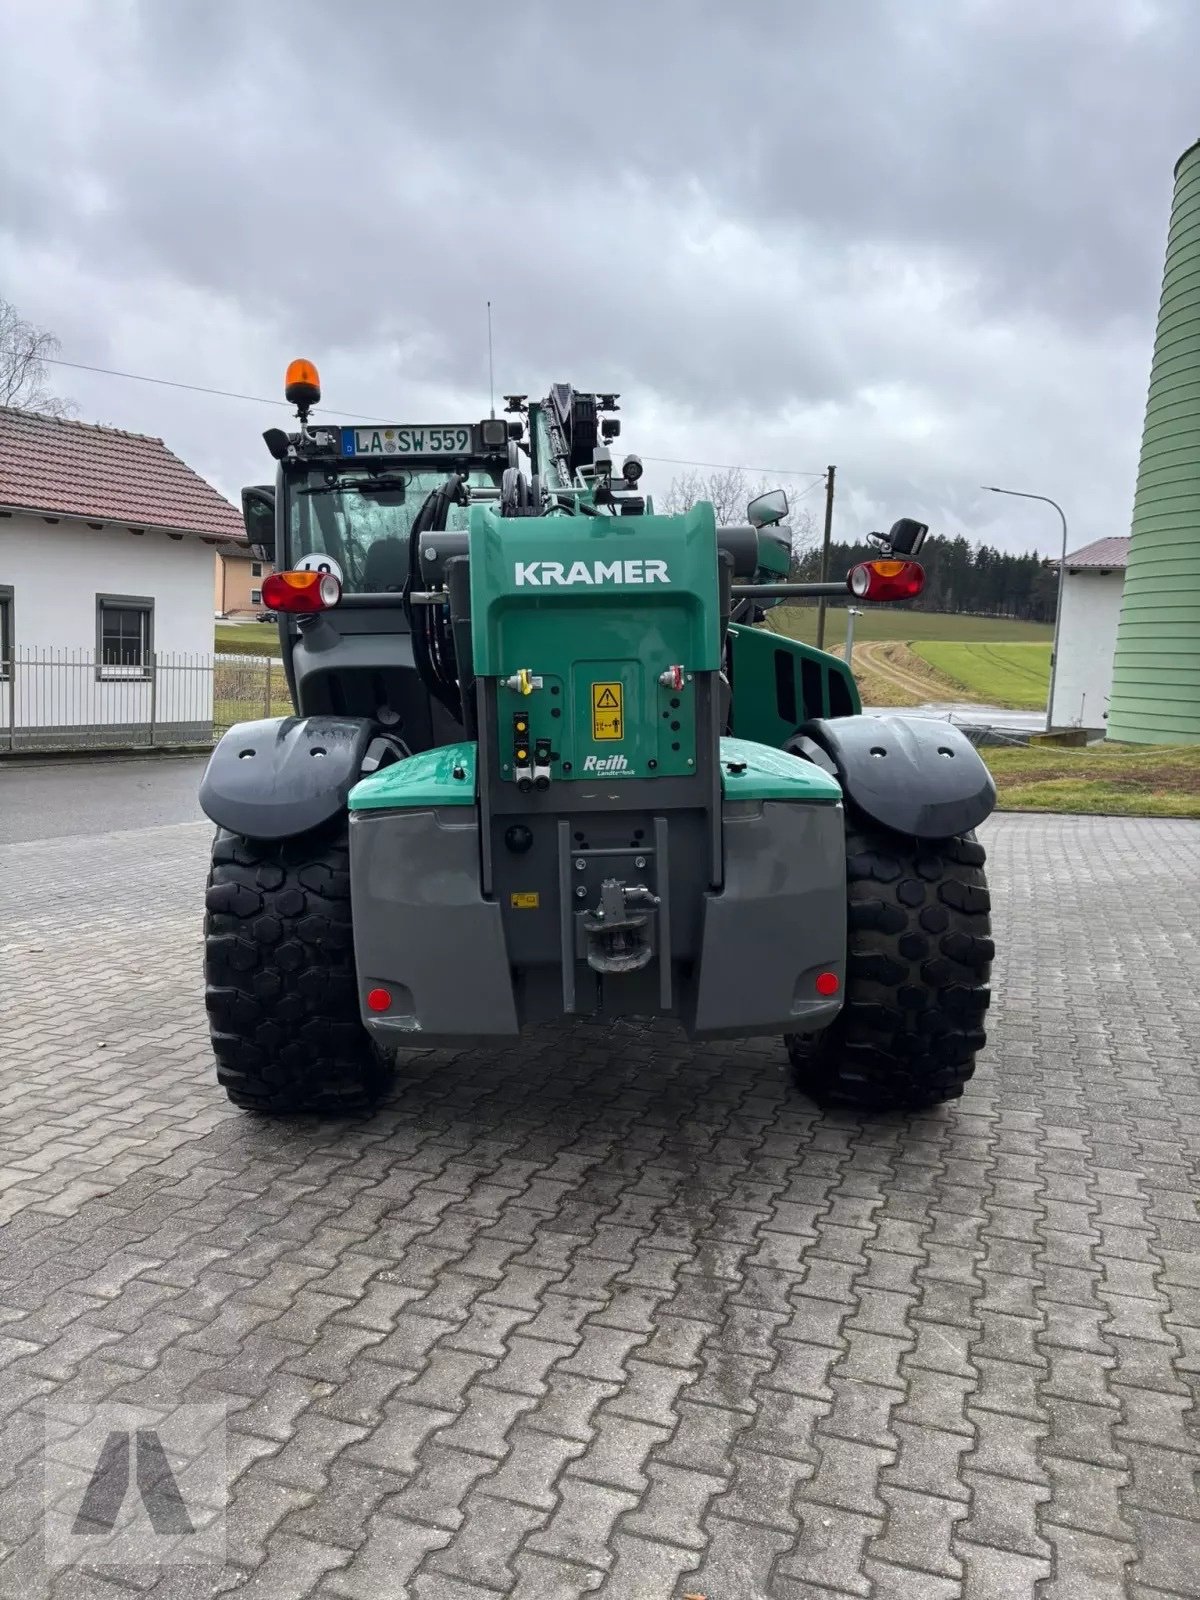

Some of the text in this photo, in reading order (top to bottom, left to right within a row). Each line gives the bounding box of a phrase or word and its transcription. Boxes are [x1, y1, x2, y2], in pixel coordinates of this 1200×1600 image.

[355, 431, 383, 453] LA
[398, 430, 424, 452] SW
[429, 430, 469, 451] 559
[514, 559, 671, 586] KRAMER
[583, 754, 628, 770] Reith
